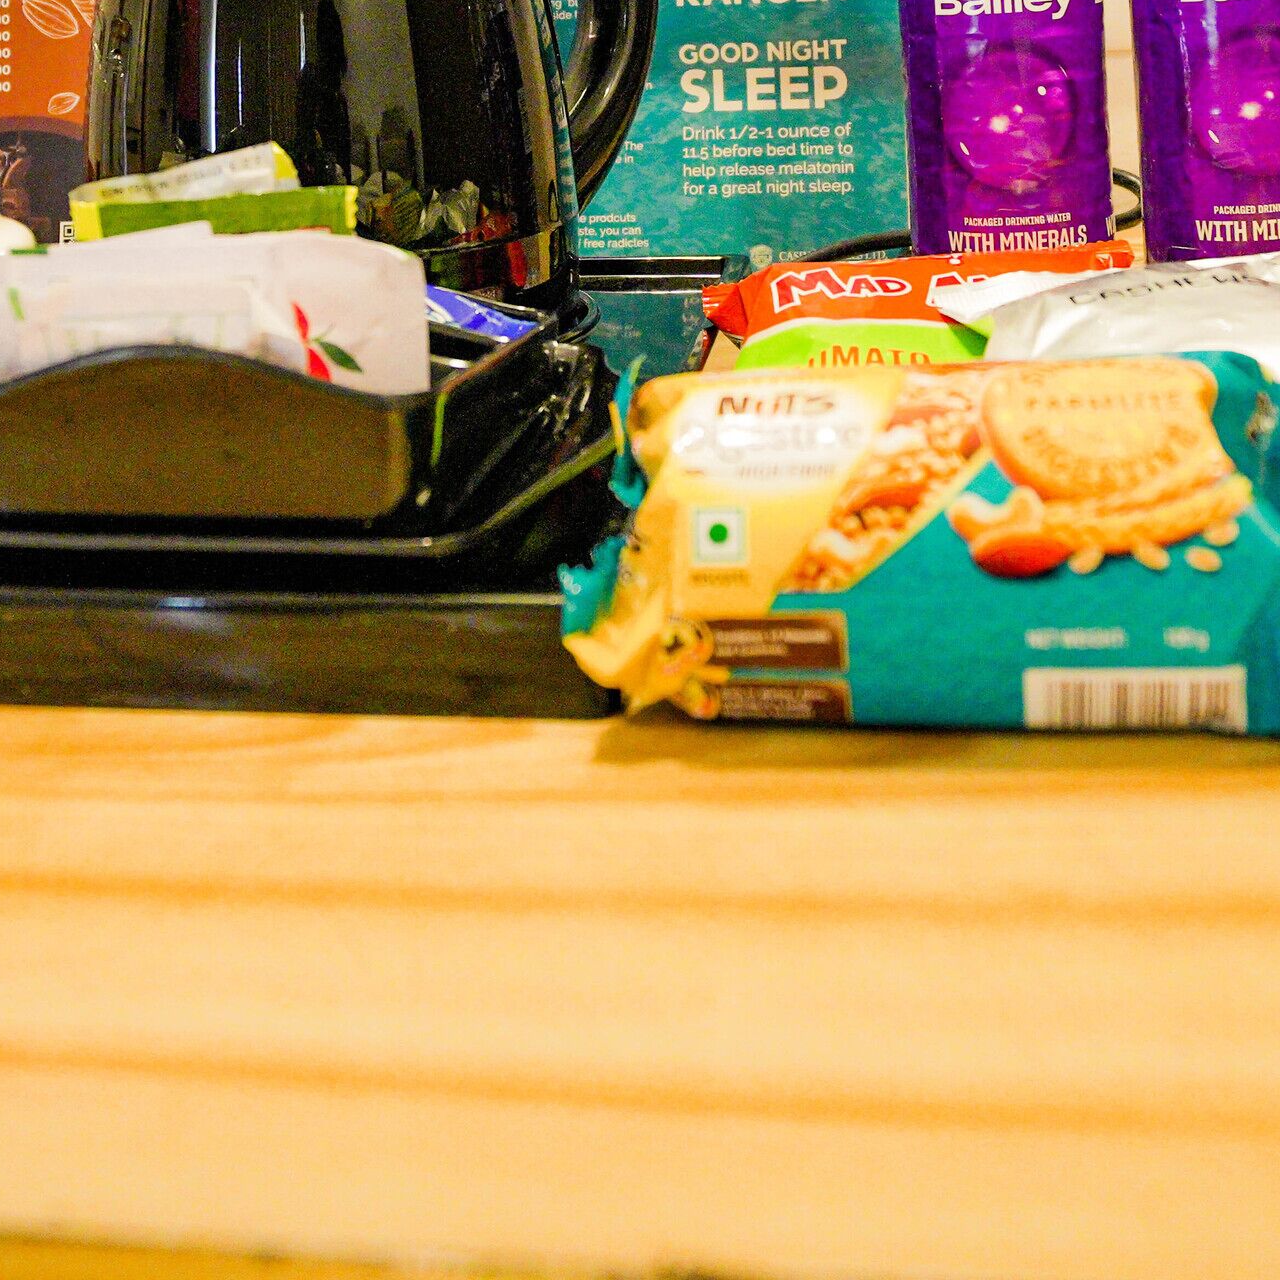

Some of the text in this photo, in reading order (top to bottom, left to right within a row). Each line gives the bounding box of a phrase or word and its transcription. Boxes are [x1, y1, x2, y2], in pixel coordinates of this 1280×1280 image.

[678, 39, 848, 65] GOOD NIGHT
[681, 65, 848, 114] SLEEP
[682, 121, 853, 141] Drink 1/2-1 ounce of
[712, 143, 763, 158] before
[766, 142, 796, 157] bed
[800, 142, 834, 156] time
[838, 141, 854, 156] to
[683, 160, 854, 180] help release melatonin
[683, 179, 855, 198] for a great night sleep.
[589, 212, 637, 224] prodcuts
[964, 212, 1071, 227] PACKAGED DRINKING WATER
[1213, 205, 1256, 215] PACKAGED
[600, 227, 620, 238] you
[622, 226, 642, 236] can
[947, 229, 994, 254] WITH
[1000, 224, 1088, 252] MINERALS
[1195, 219, 1247, 242] WITH
[584, 237, 650, 249] free radicles
[772, 267, 912, 314] MAD
